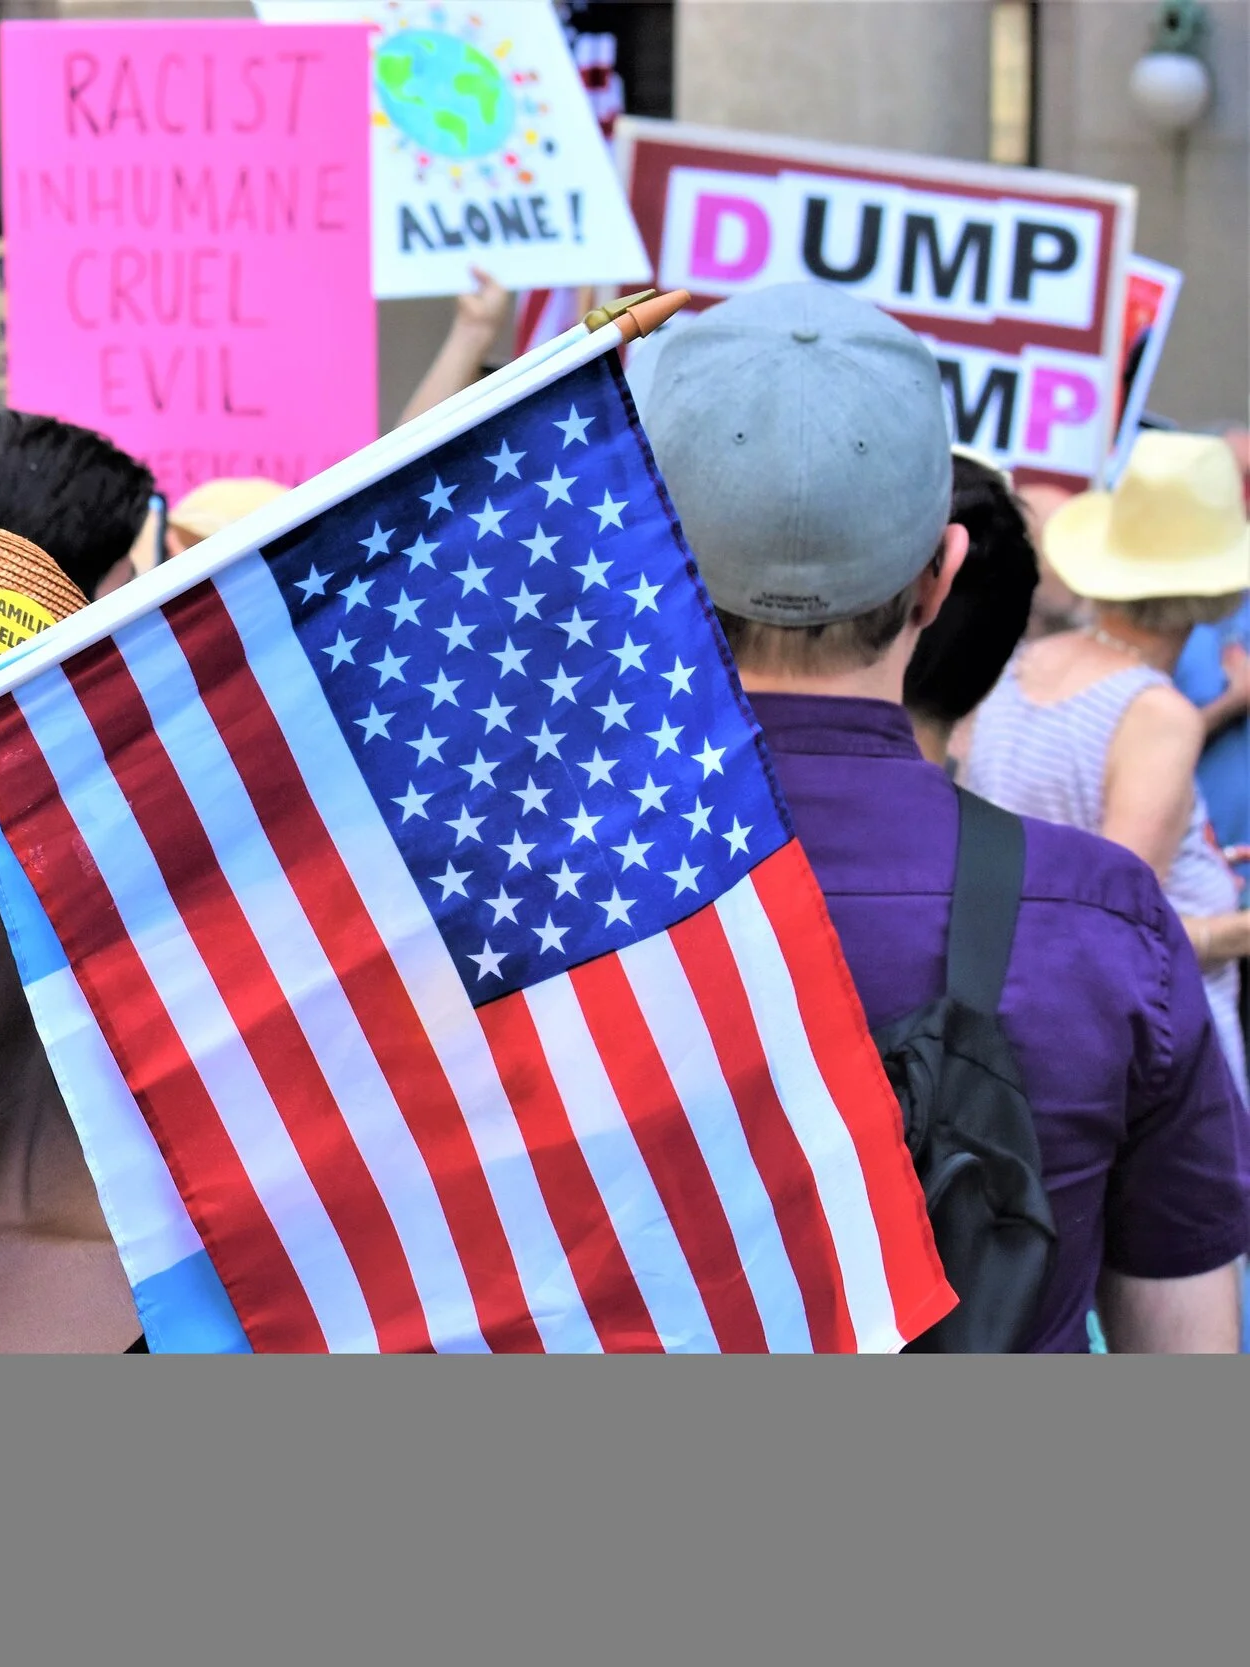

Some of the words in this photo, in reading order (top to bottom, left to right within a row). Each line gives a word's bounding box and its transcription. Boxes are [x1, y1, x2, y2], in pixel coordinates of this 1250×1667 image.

[63, 50, 324, 137] RACIST
[16, 163, 347, 235] INHUMANE
[688, 191, 1080, 304] DUMP
[65, 246, 267, 330] CRUEL
[101, 346, 266, 416] EVIL
[149, 450, 307, 497] ERICAN
